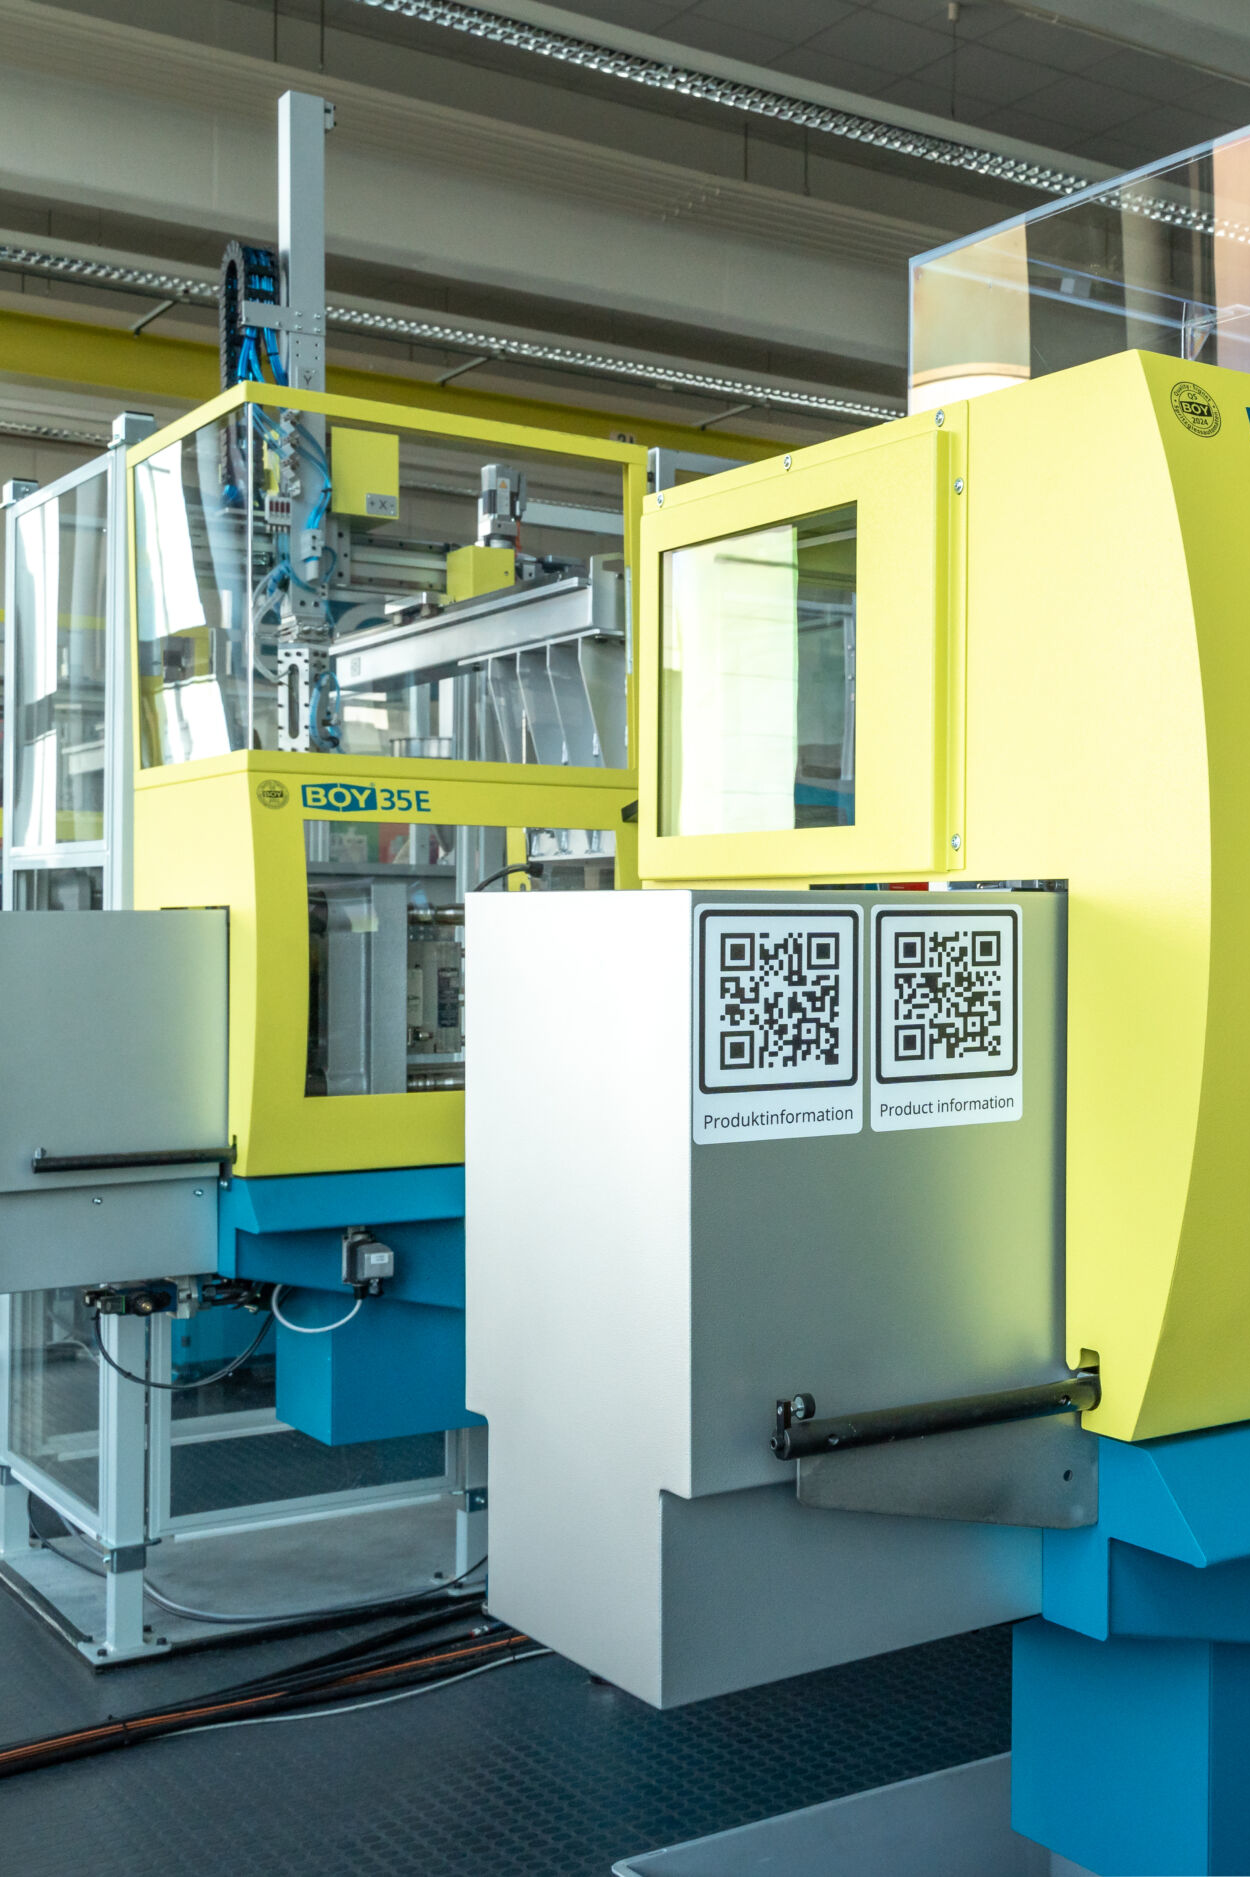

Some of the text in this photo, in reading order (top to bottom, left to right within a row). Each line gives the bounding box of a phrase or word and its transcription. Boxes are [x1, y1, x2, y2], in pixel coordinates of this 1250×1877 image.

[1181, 402, 1209, 416] BOY
[304, 785, 432, 813] BOY 35E
[703, 1106, 854, 1130] Produktinformation
[879, 1095, 1015, 1118] Product information
